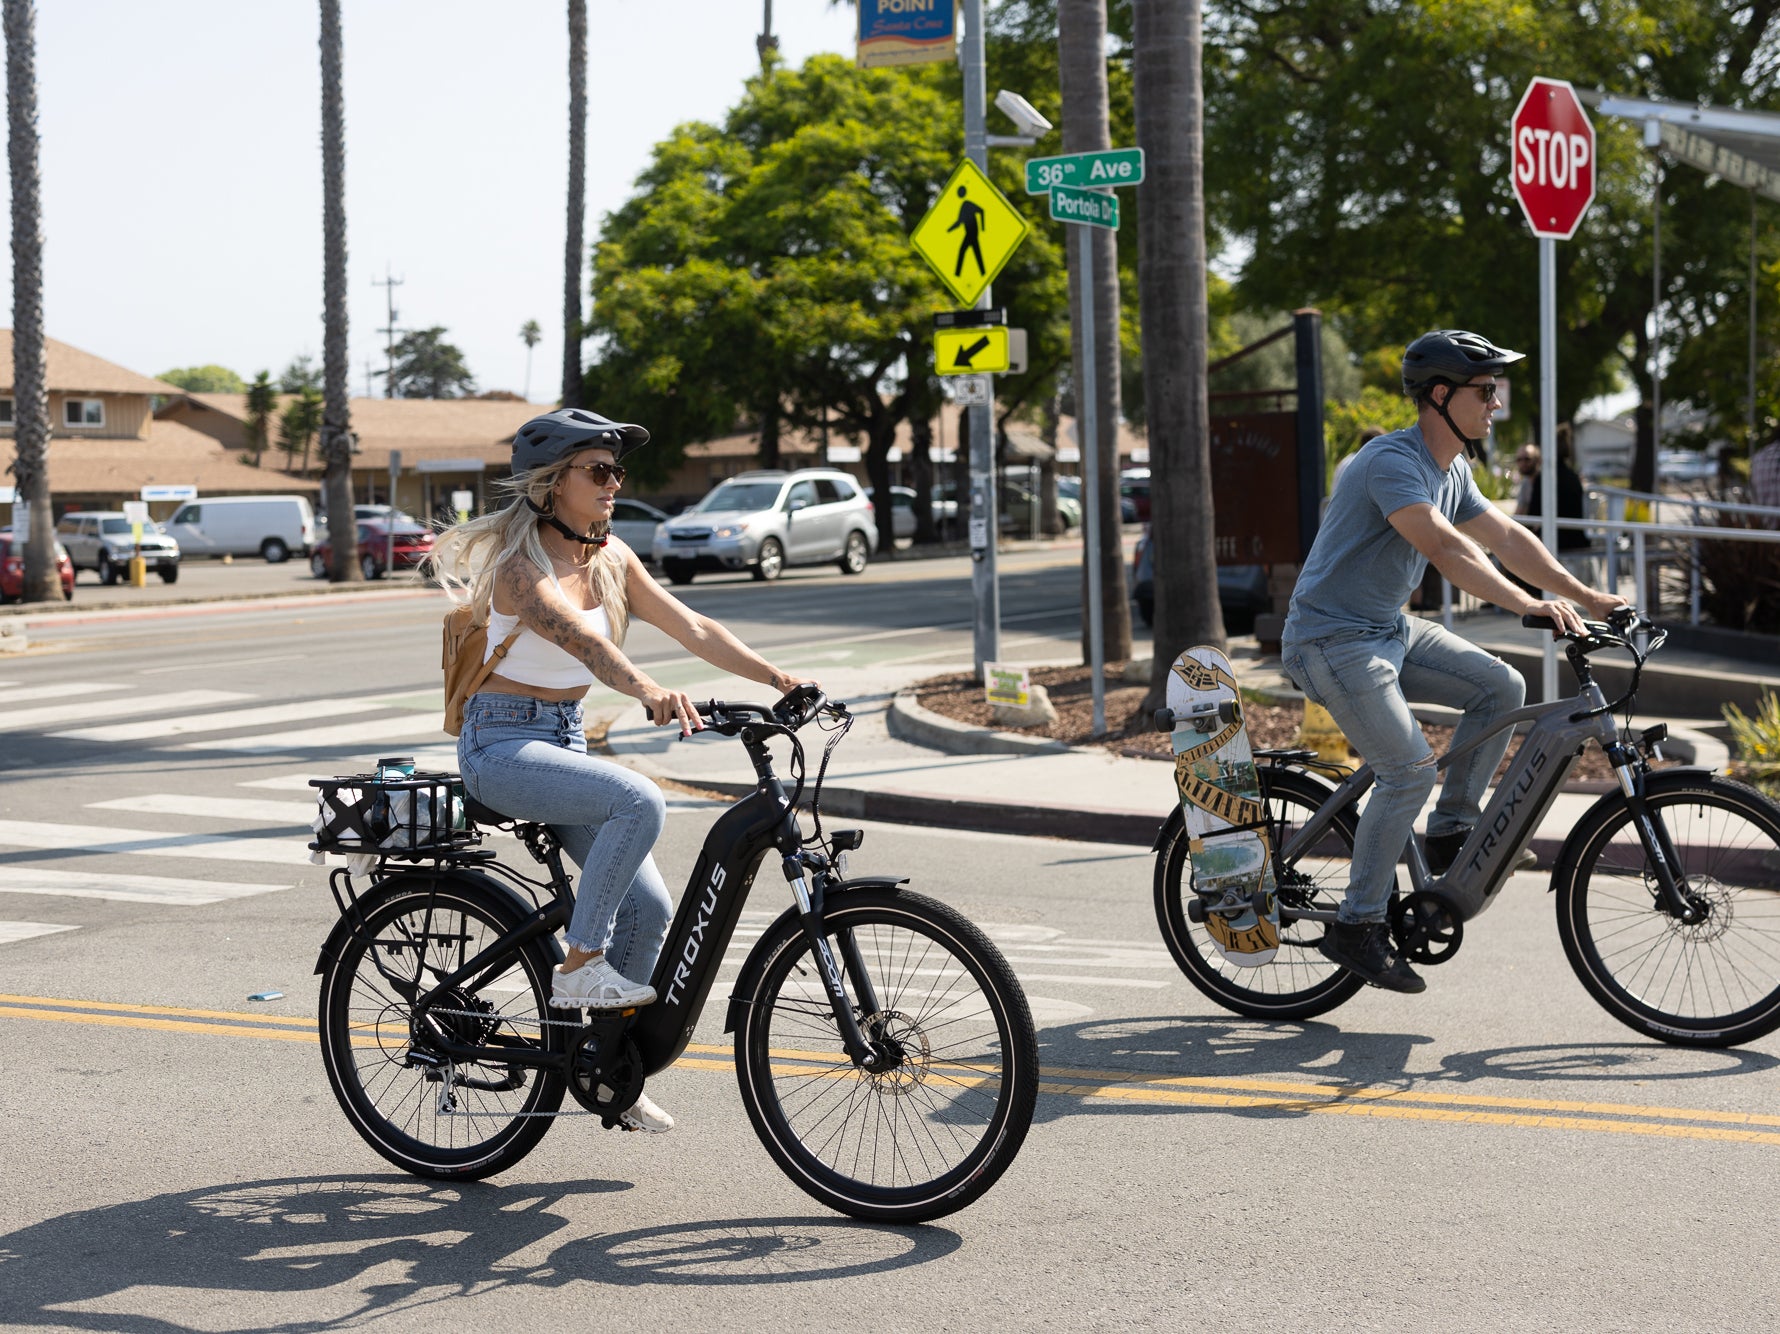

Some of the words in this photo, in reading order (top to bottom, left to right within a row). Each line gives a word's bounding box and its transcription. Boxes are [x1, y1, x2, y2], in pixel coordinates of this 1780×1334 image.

[877, 0, 934, 14] POINT
[1090, 159, 1132, 180] Ave
[1517, 125, 1590, 190] STOP
[1056, 192, 1100, 218] Portola
[1101, 201, 1113, 220] Dr
[1469, 747, 1547, 872] TROXUS
[665, 862, 727, 1006] TROXUS
